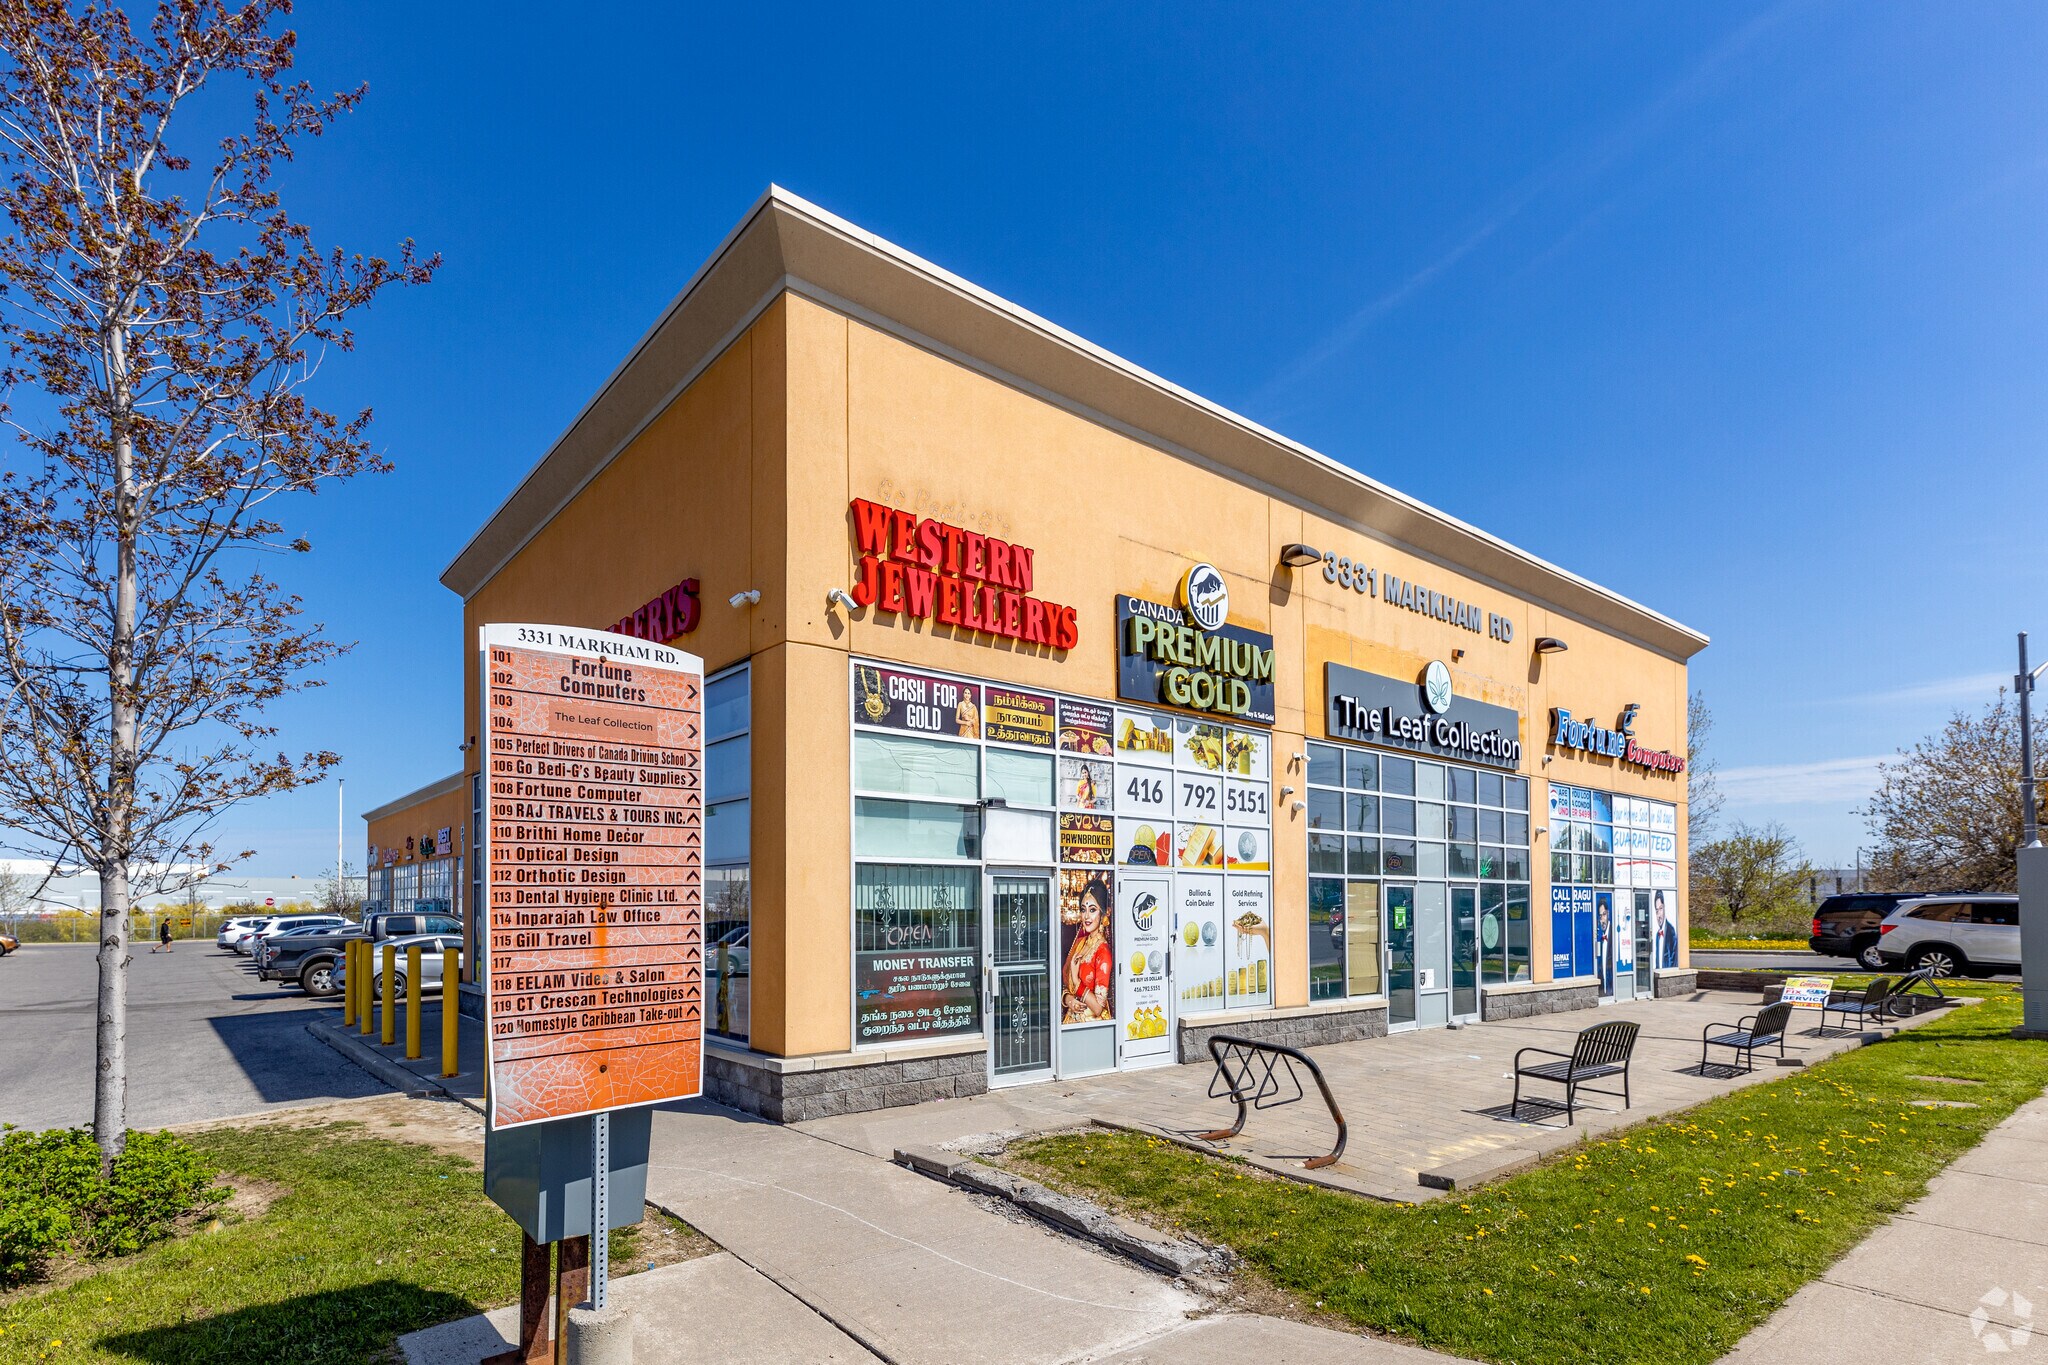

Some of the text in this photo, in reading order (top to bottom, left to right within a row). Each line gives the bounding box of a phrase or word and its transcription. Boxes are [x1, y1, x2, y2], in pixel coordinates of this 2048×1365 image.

[850, 497, 1034, 594] WESTERN
[852, 555, 1079, 650] JEWELLERYS
[1322, 551, 1514, 643] 3331 MARKHAM RD
[1128, 597, 1185, 626] CANADA
[493, 651, 511, 663] 101
[518, 628, 679, 665] 3331 MARKHAM RD.
[1131, 615, 1276, 683] PREMIUM
[493, 673, 513, 685] 102
[572, 659, 632, 682] Fortune
[560, 676, 646, 701] Computers
[889, 675, 958, 709] CASH FOR
[1166, 666, 1251, 714] GOLD
[493, 695, 513, 707] 103
[493, 717, 513, 729] 104
[555, 712, 653, 732] The Leaf Collection
[906, 706, 941, 731] GOLD
[1338, 694, 1522, 760] The Leaf Collection
[1555, 707, 1626, 758] Fortune
[494, 738, 686, 767] 105 Perfect Drivers of Canada Driving School
[1627, 738, 1685, 772] Computers
[494, 760, 686, 785] 106 Go Bedi-G's Beauty Supplies
[494, 782, 642, 802] 108 Fortune Computer
[1127, 777, 1267, 814] 416 792 5151
[494, 803, 686, 825] 109 RAJ TRAVELS & TOURS INC.
[494, 825, 645, 843] 110 Brithi Home Decor
[1060, 833, 1111, 846] PAWNBROKER
[1614, 831, 1672, 852] GUARANTEED
[494, 847, 619, 863] 111 Optical Design
[493, 869, 626, 884] 112 Orthotic Design
[493, 888, 678, 905] 113 Dental Hygiene Clinic Ltd.
[1185, 899, 1215, 907] Coin Dealer
[1188, 889, 1206, 897] Bullion
[1232, 889, 1263, 898] Gold Refining
[1238, 899, 1257, 907] Services
[1552, 889, 1591, 901] CALL RAGU
[493, 909, 661, 927] 114 Inparajah Law Office
[493, 931, 592, 948] 115 Gill Travel
[888, 924, 932, 945] OPEN
[493, 957, 511, 969] 117
[873, 956, 974, 972] MONEY TRANSFER
[493, 969, 665, 991] 118 EELAM Video & Salon
[493, 987, 684, 1012] 119 CT Crescan Technologies
[494, 1006, 683, 1034] 120 Homestyle Caribbean Take-out
